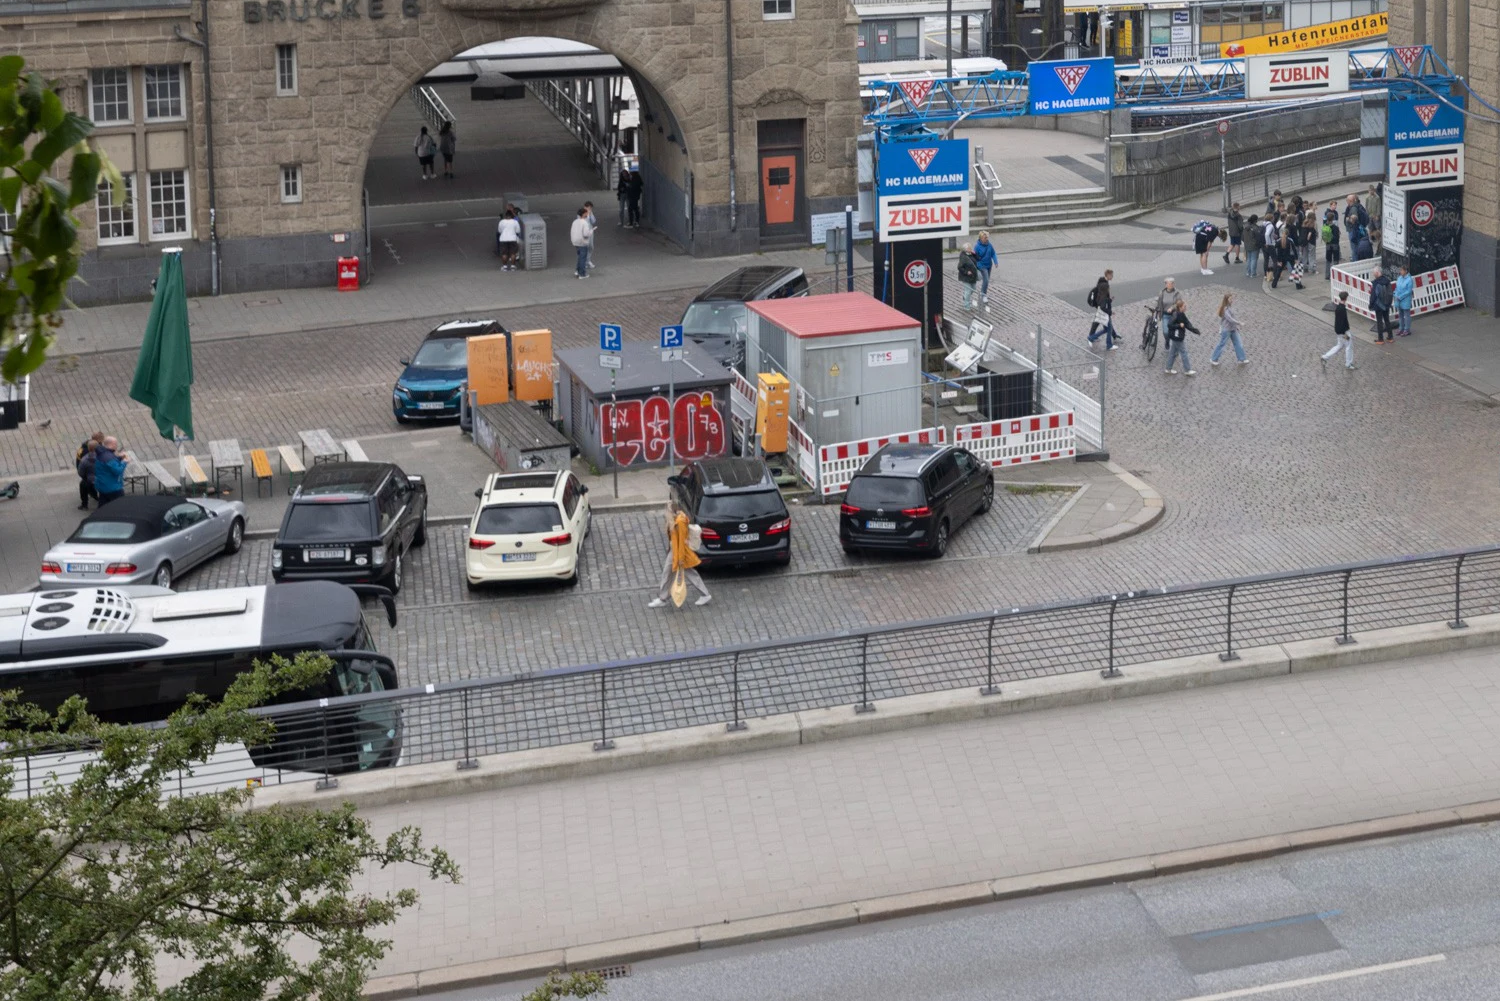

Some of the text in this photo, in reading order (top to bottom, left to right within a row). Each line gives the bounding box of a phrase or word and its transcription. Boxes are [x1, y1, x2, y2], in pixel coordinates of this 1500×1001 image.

[1316, 29, 1379, 46] SPEICHERSTADT
[1157, 56, 1198, 65] HAGEMANN
[1270, 65, 1329, 83] ZÜBLIN
[1035, 97, 1110, 111] HC HAGEMANN
[1395, 127, 1460, 141] HC HAGEMANN
[1396, 157, 1458, 178] ZÜBLIN
[885, 177, 901, 188] HC
[903, 173, 964, 186] HAGEMANN
[888, 205, 962, 228] ZÜBLIN
[605, 328, 617, 347] P
[663, 328, 677, 346] P
[870, 351, 892, 362] TMS
